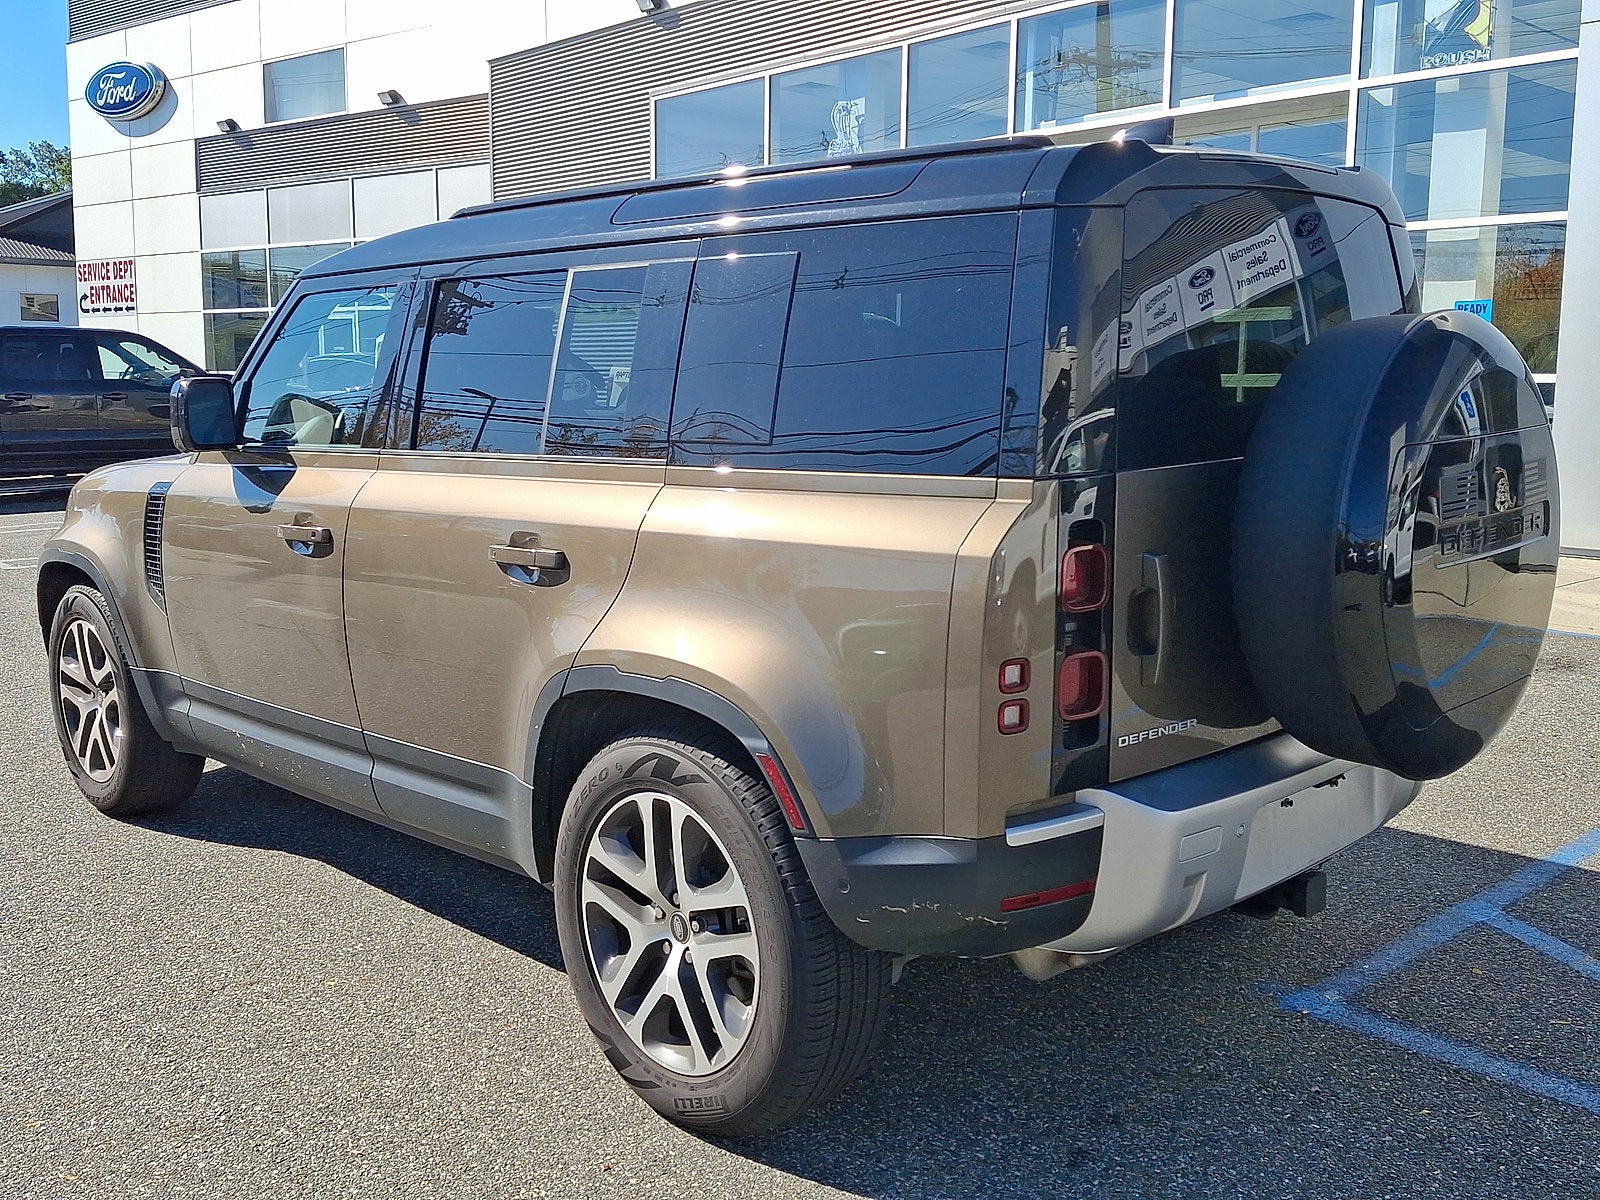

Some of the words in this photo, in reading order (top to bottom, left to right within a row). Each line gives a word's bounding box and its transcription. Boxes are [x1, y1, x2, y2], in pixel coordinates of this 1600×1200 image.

[96, 71, 137, 106] Ford
[78, 261, 111, 283] SERVICE
[112, 259, 134, 280] DEPT
[89, 283, 135, 305] ENTRANCE
[1441, 511, 1543, 556] DEFENDER
[1117, 718, 1198, 748] DEFENDER
[673, 1095, 730, 1116] PIRELLI
